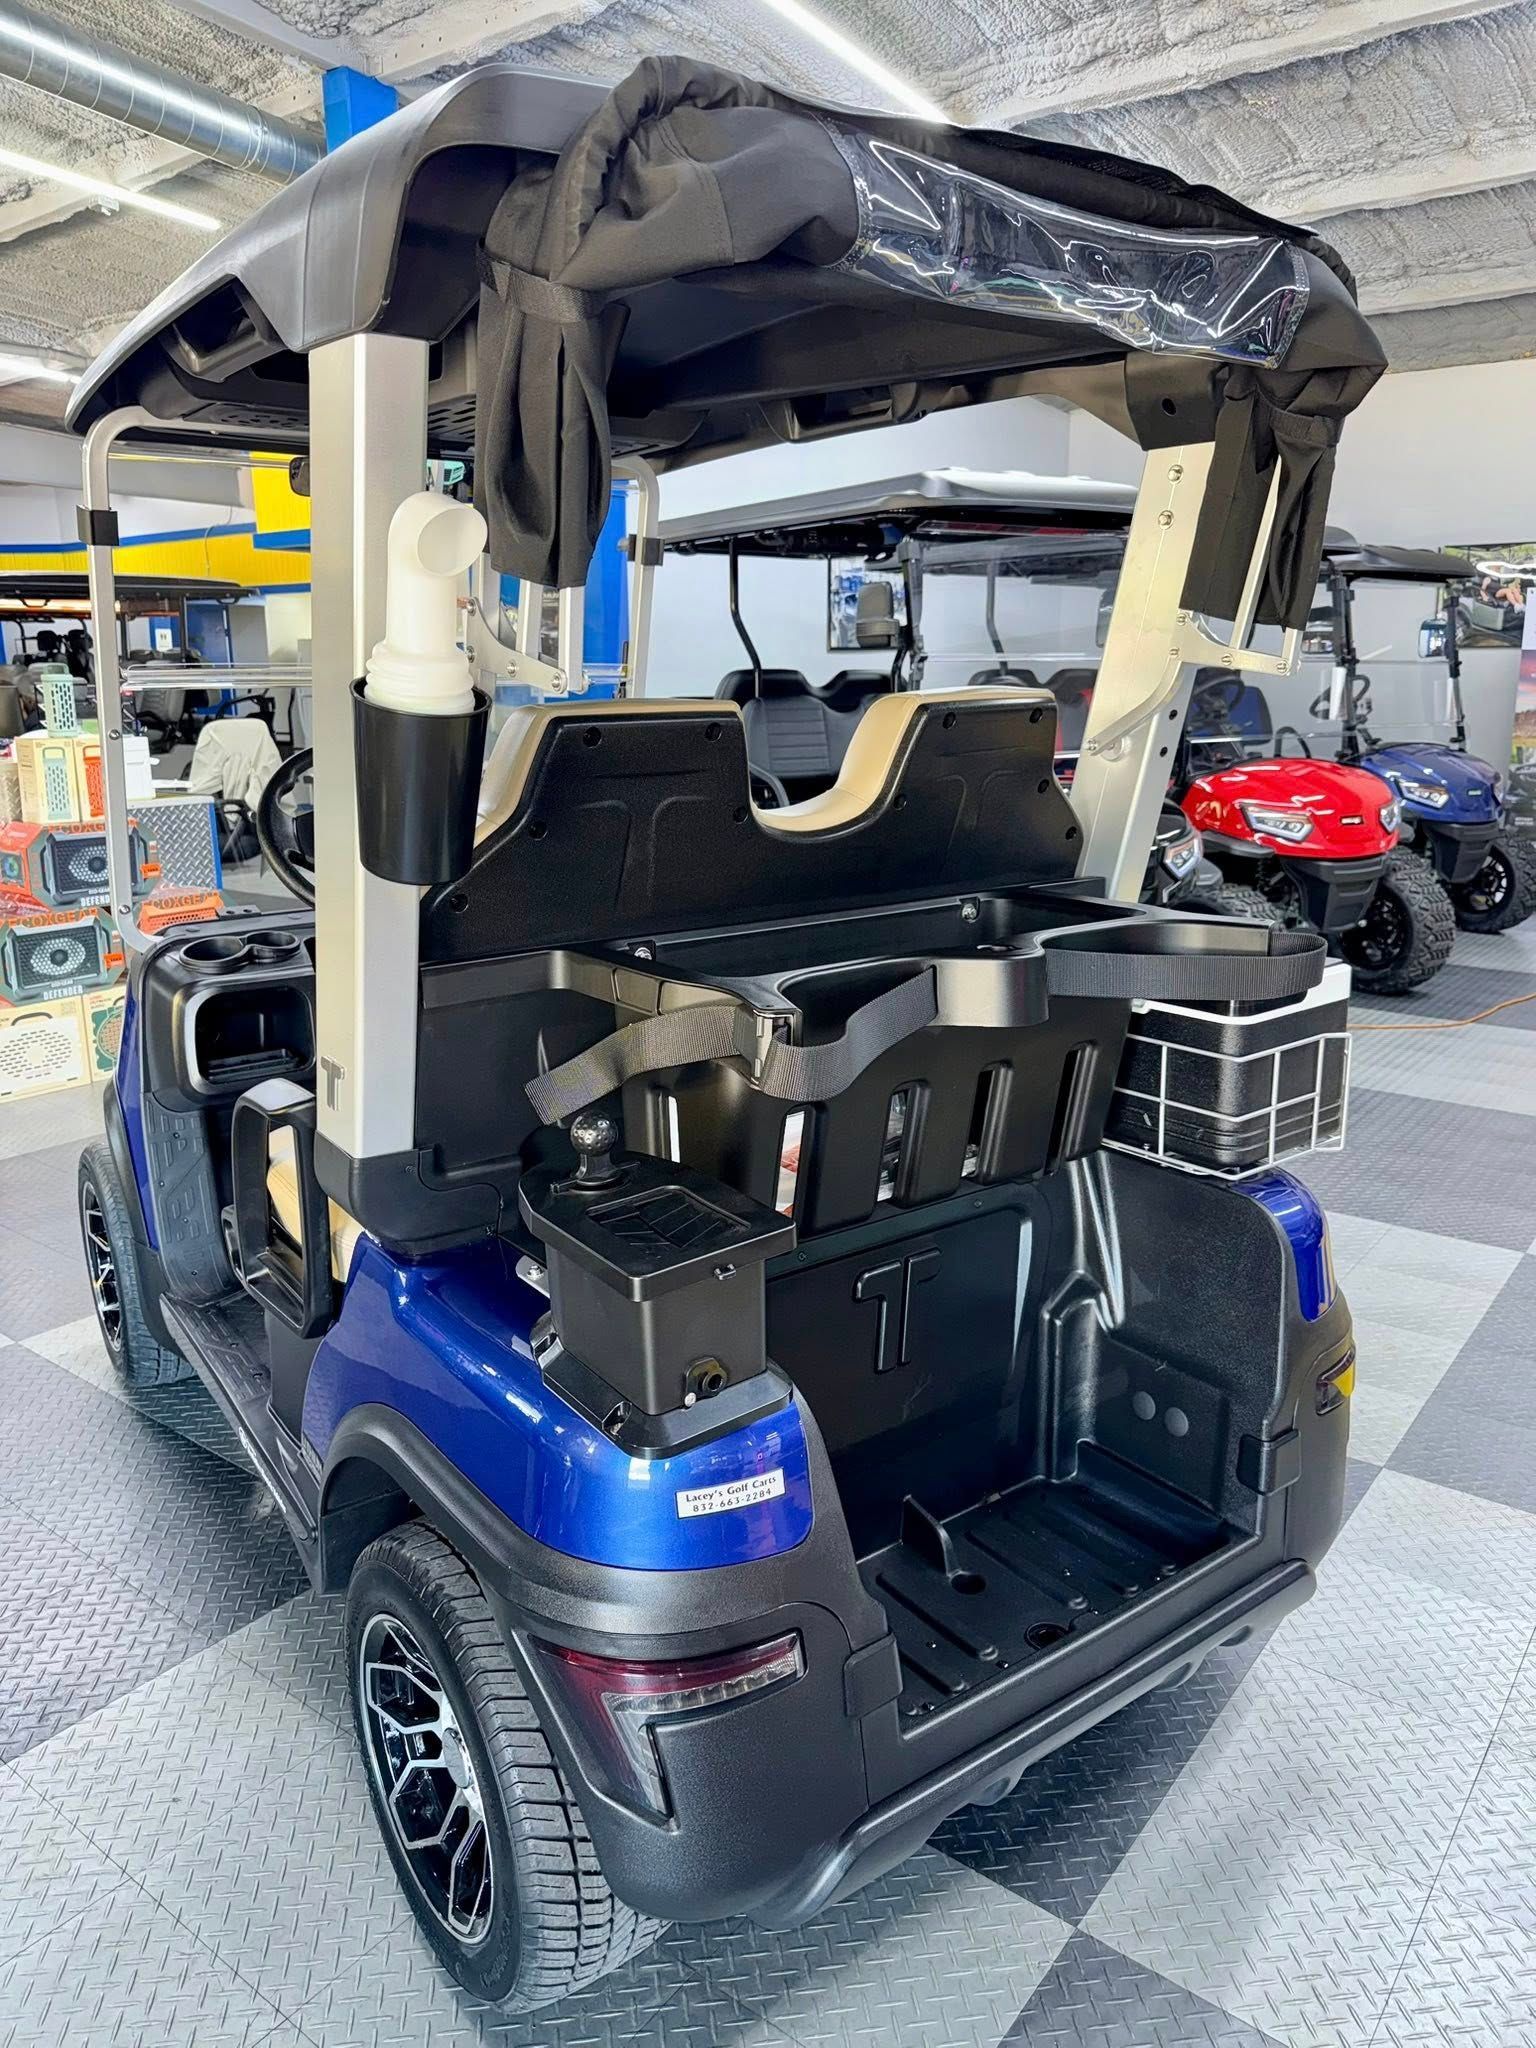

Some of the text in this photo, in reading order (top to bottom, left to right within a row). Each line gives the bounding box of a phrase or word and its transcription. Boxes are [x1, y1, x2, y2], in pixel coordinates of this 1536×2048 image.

[80, 894, 110, 907] DEFEND
[43, 985, 83, 1000] DEFENDER
[686, 1476, 776, 1503] Lacey's Golf Carts
[693, 1487, 771, 1513] 832-663-2284
